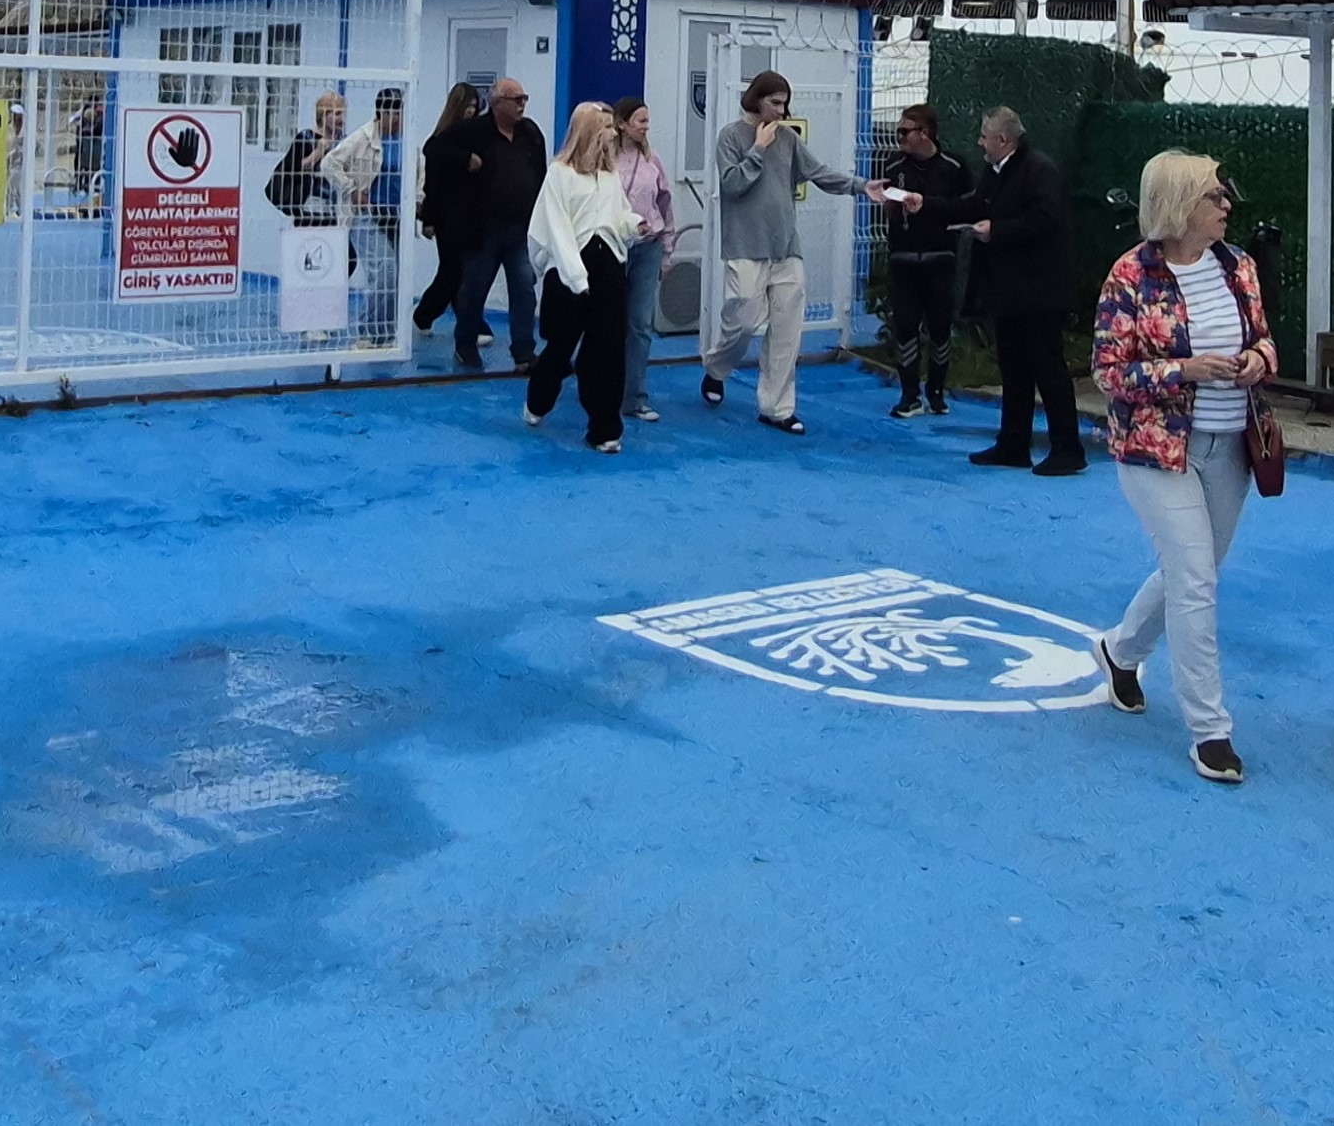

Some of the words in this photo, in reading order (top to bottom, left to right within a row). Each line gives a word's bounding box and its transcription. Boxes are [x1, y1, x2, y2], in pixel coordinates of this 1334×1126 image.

[158, 189, 209, 205] DEĞERLİ
[171, 225, 221, 237] PERSONEL
[224, 225, 237, 236] VE
[132, 239, 185, 251] YOLCULAR
[123, 271, 161, 292] GİRİŞ
[166, 273, 234, 288] YASAKTIR
